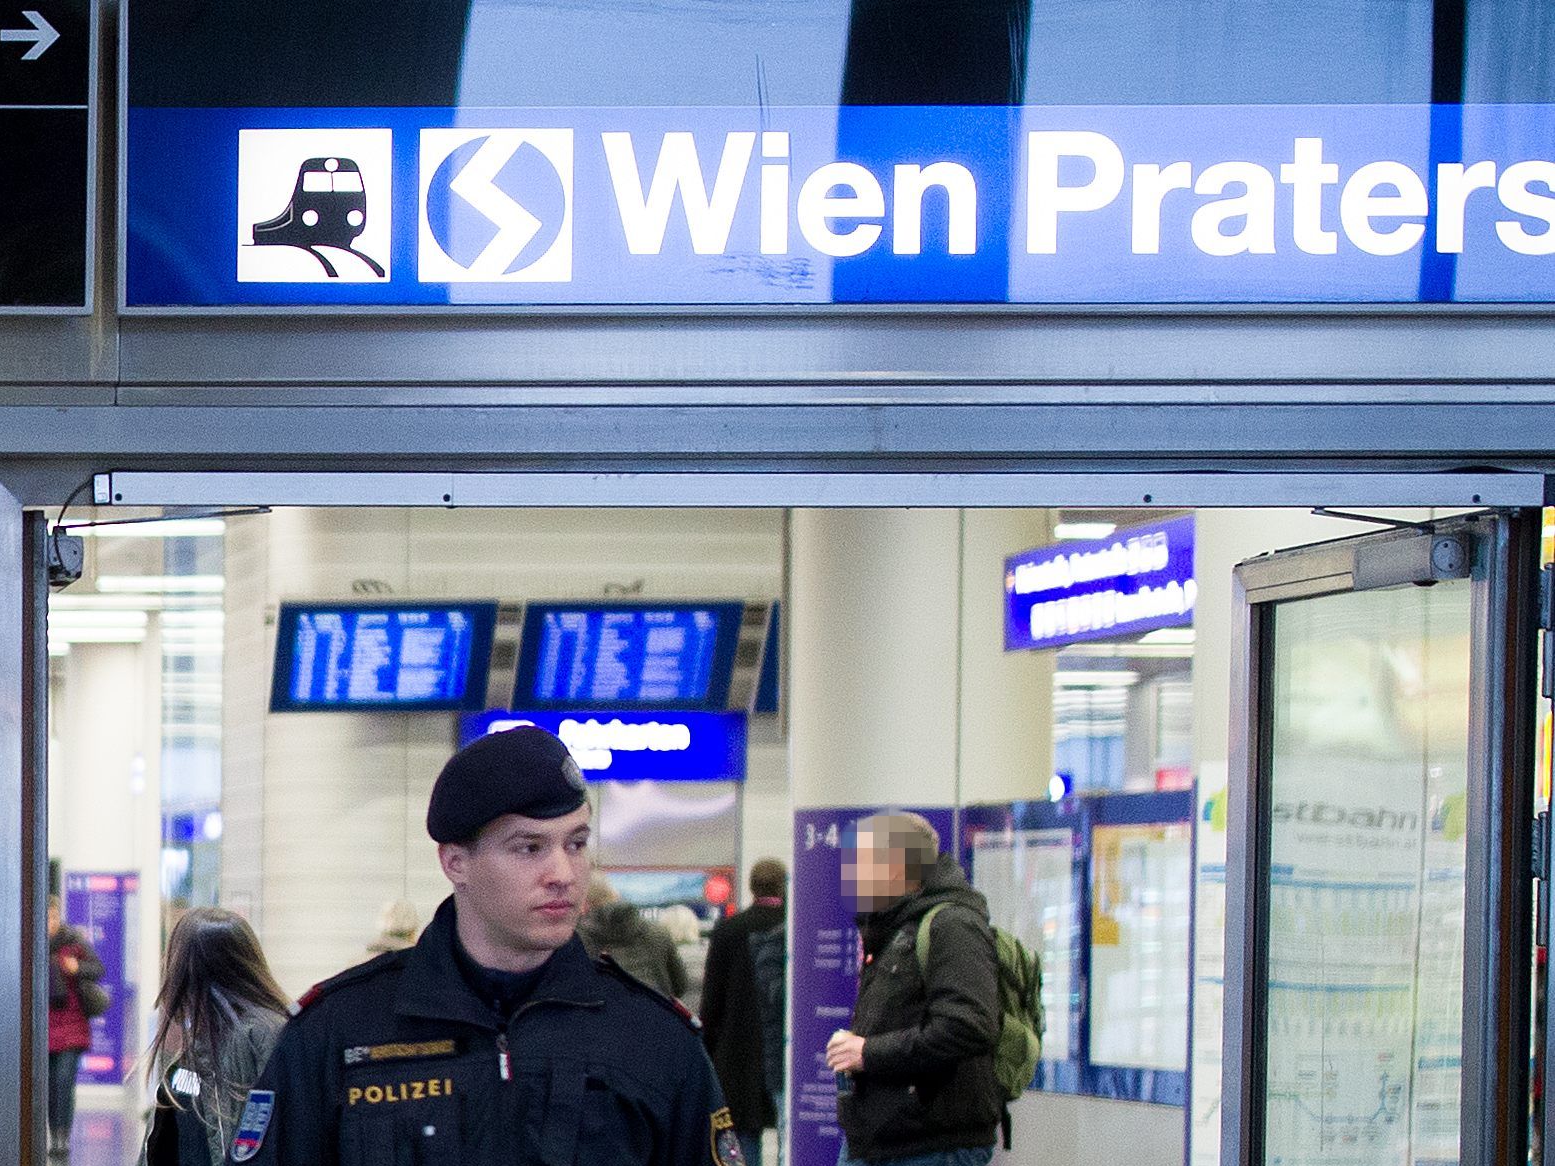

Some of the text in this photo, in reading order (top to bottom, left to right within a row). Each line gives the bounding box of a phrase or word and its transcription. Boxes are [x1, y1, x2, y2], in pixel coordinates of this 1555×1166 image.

[601, 130, 1555, 257] Wien Praters
[348, 1078, 453, 1106] POLIZEI
